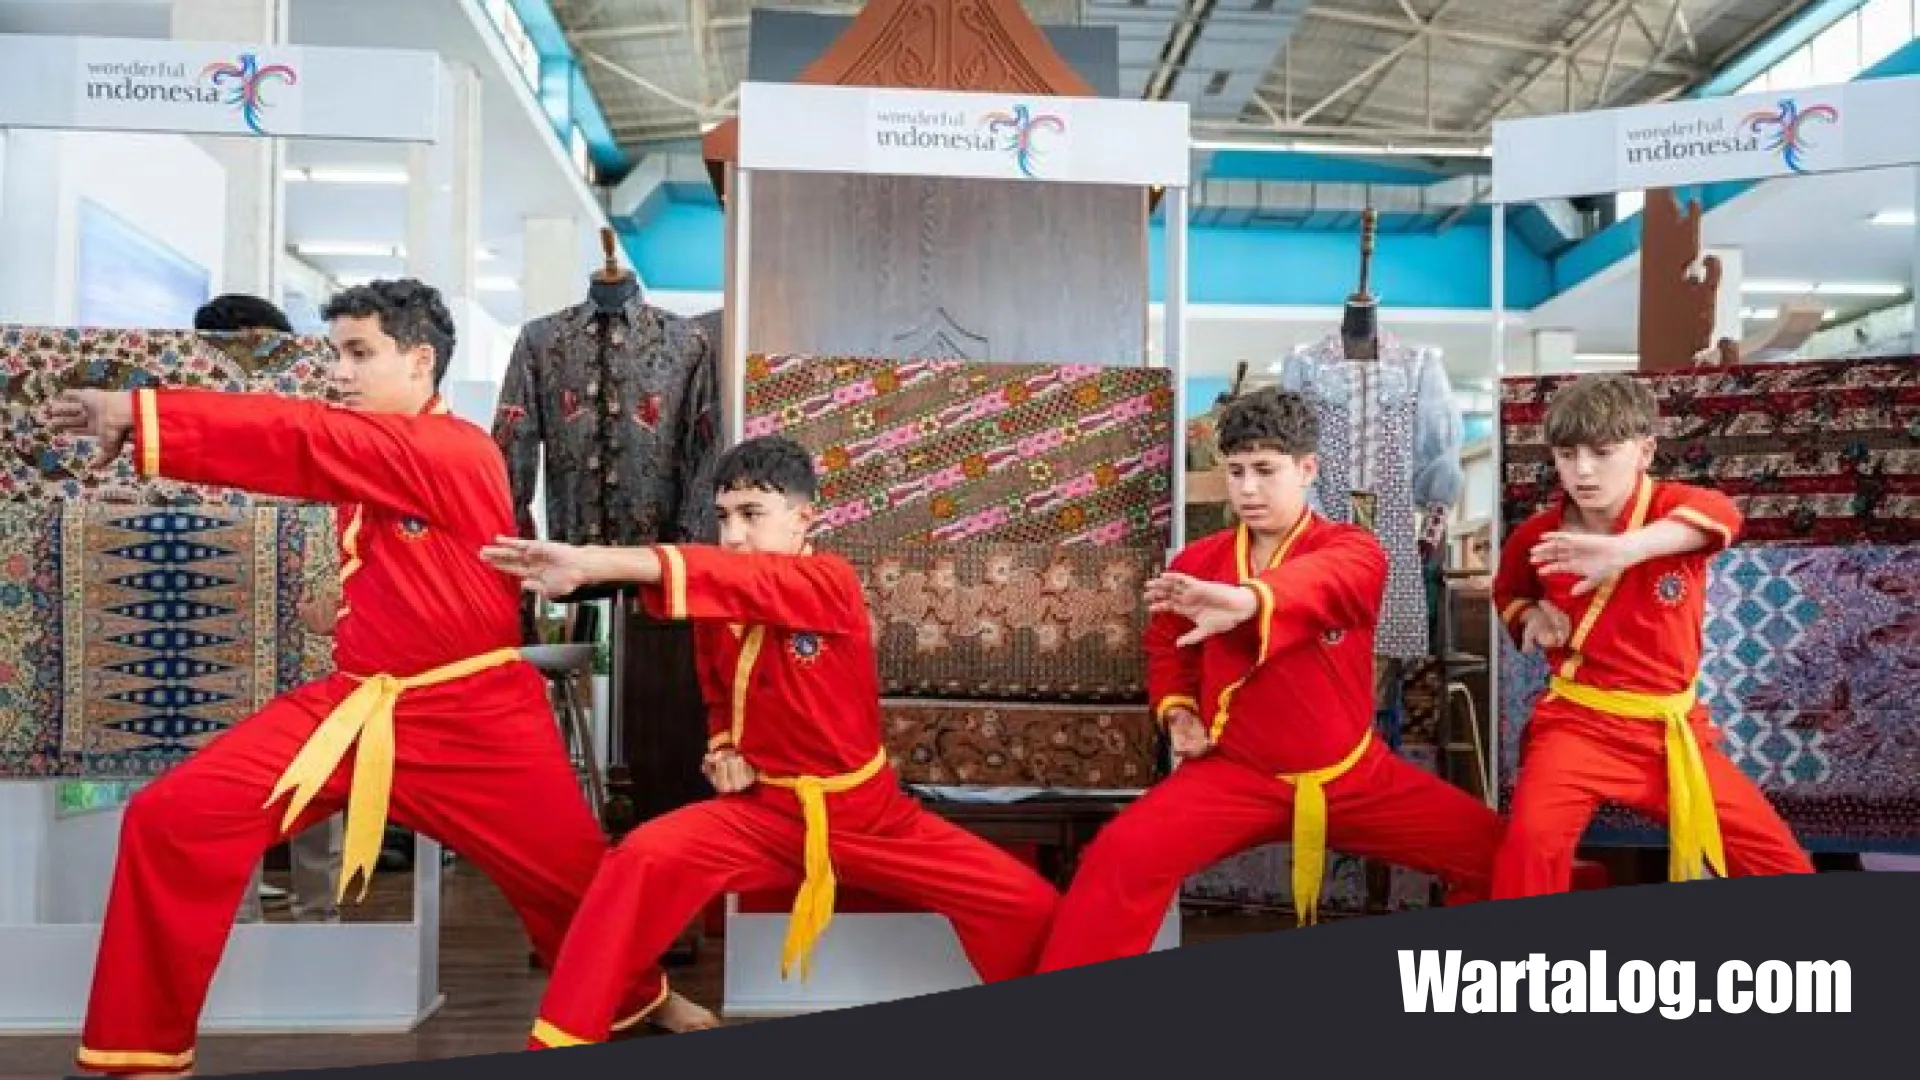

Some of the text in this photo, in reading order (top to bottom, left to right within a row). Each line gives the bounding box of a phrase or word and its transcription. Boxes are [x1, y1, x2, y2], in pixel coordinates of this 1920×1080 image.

[87, 77, 219, 102] indonesia
[877, 126, 996, 151] indonesia
[1627, 136, 1758, 163] indonesia
